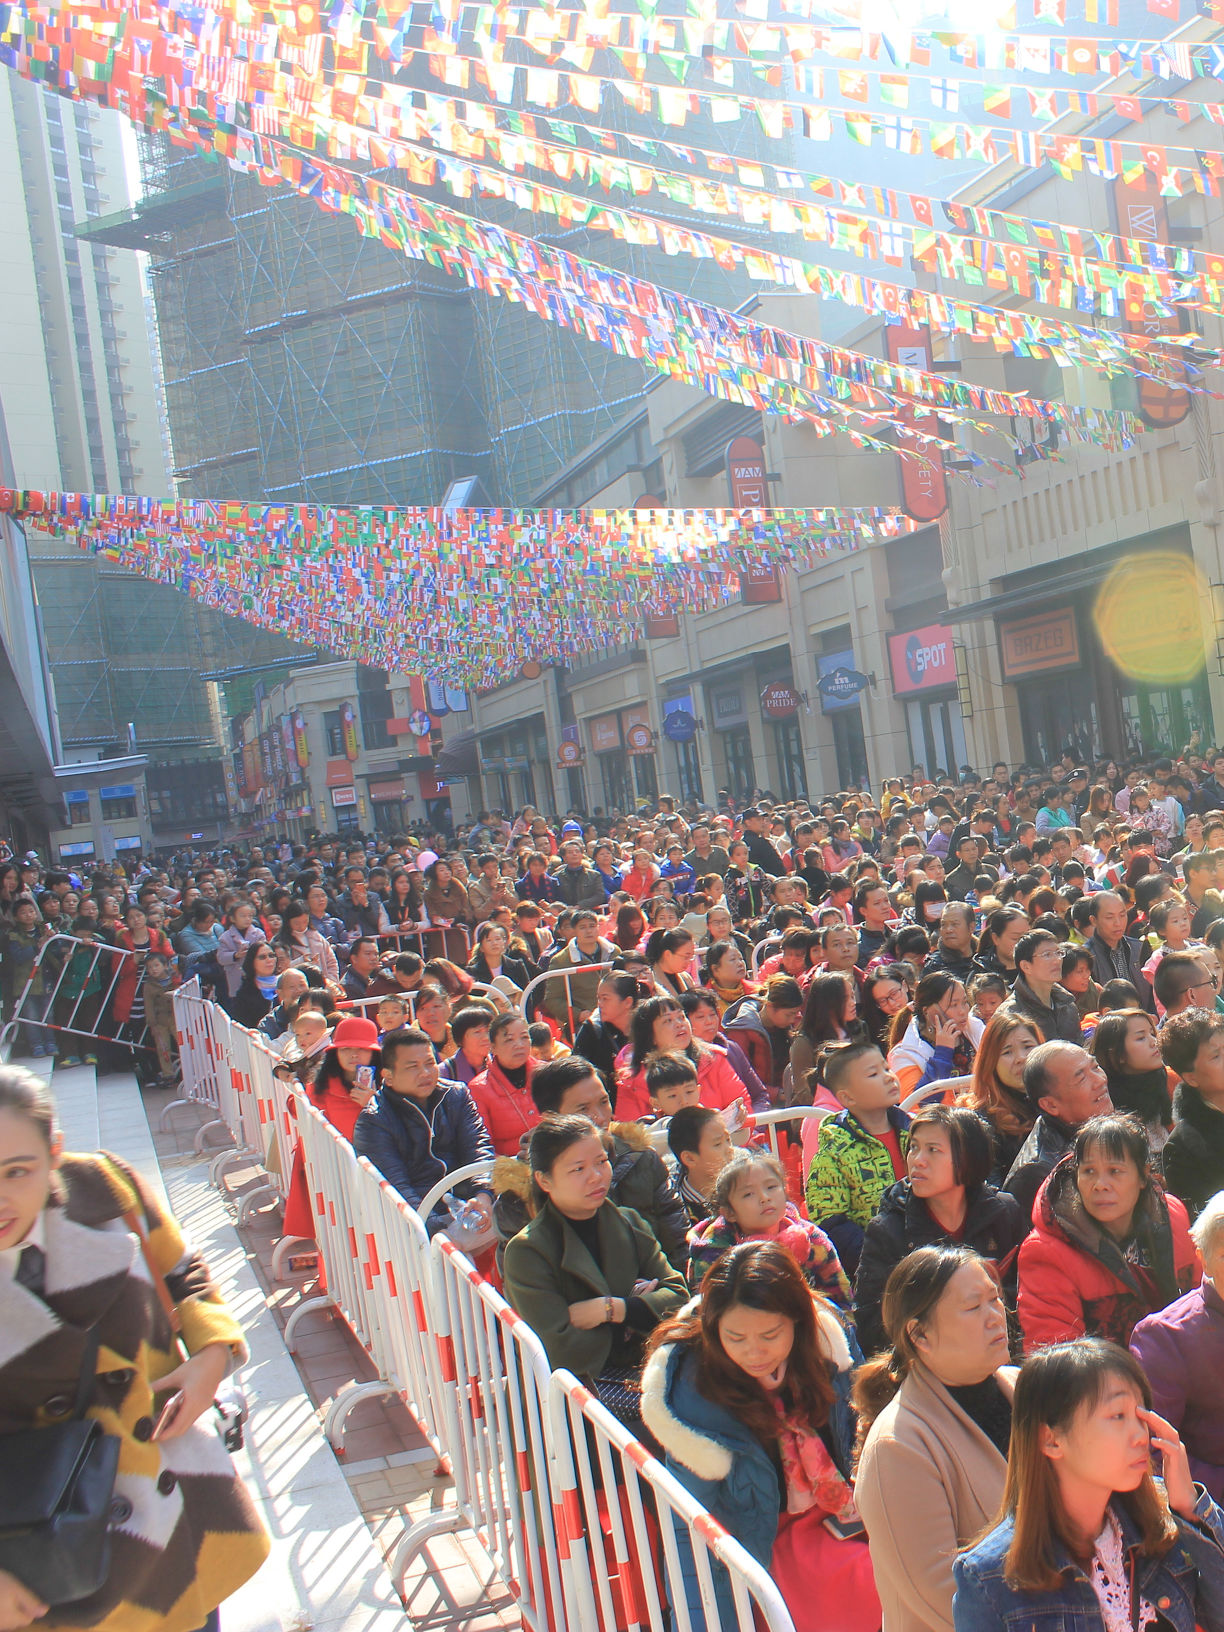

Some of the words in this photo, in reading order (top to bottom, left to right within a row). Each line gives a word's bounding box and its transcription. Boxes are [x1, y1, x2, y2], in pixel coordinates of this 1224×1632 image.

[916, 642, 947, 671] SPOT
[828, 681, 858, 692] PERFUME
[767, 698, 797, 709] PRIDE
